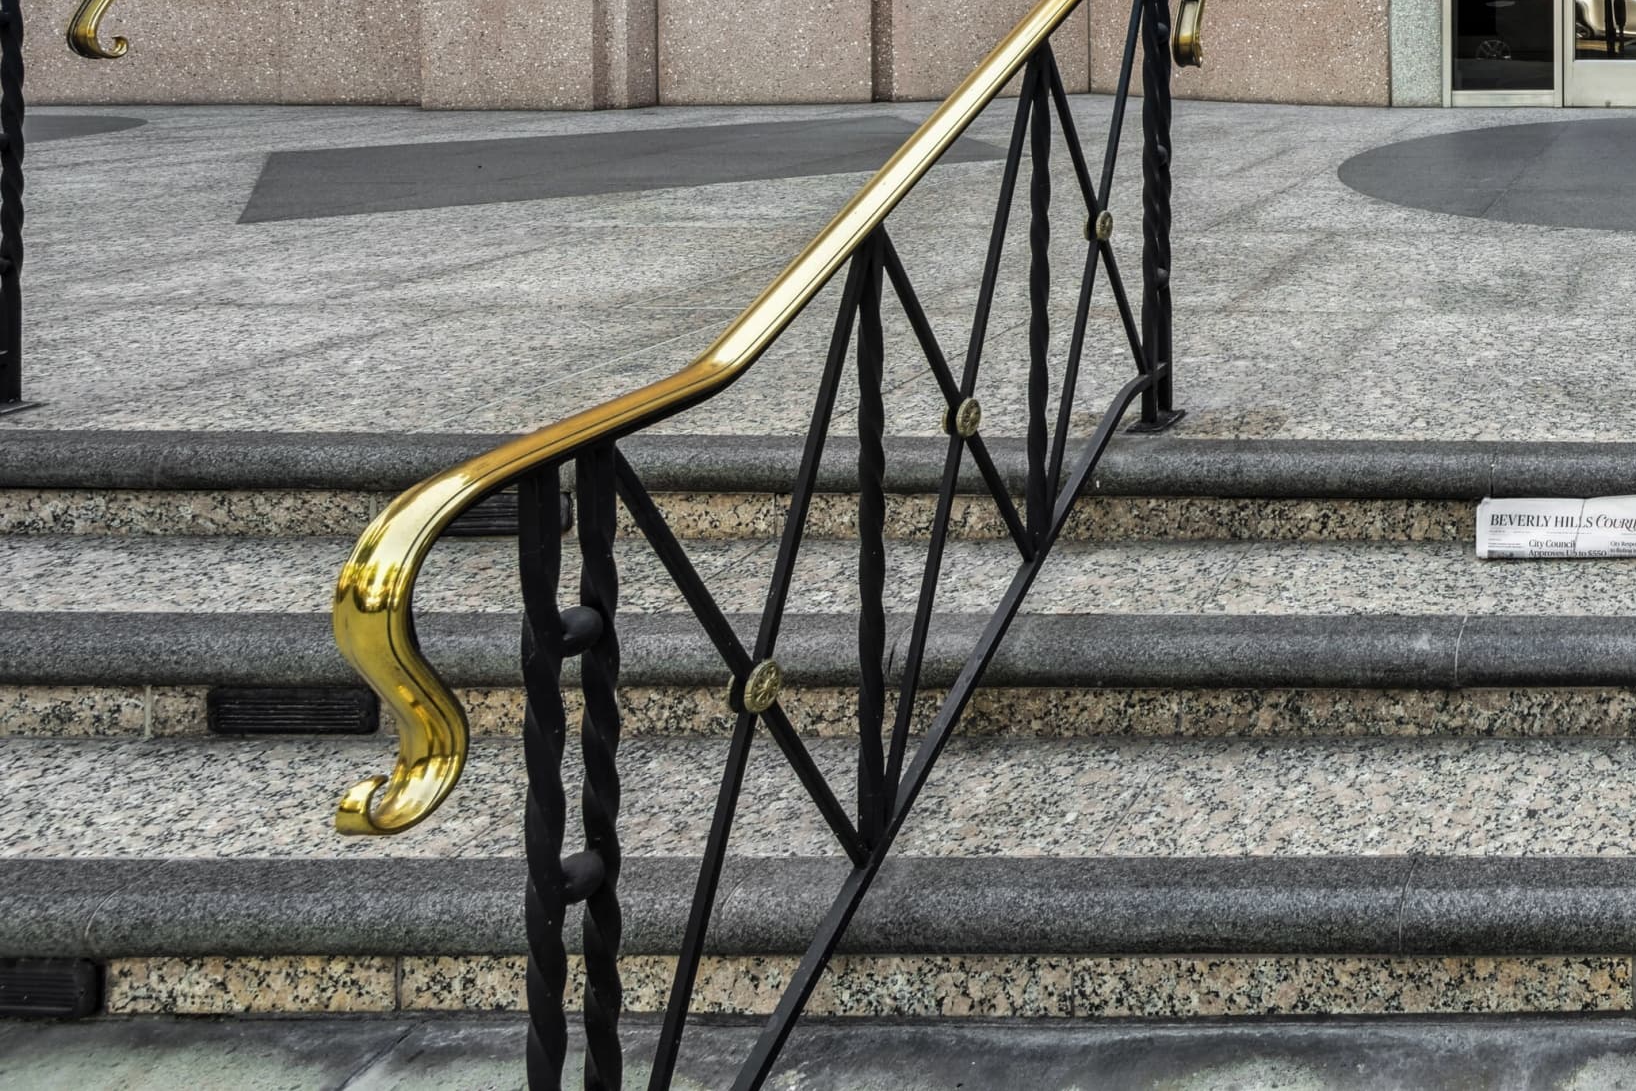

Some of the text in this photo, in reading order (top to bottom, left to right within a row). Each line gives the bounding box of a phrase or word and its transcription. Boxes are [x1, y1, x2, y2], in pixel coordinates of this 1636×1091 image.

[1490, 513, 1552, 527] BEVERLY
[1554, 515, 1593, 528] HILLS
[1529, 539, 1544, 549] City
[1545, 539, 1576, 548] Council
[1529, 549, 1565, 558] Approves
[1587, 549, 1607, 557] $550
